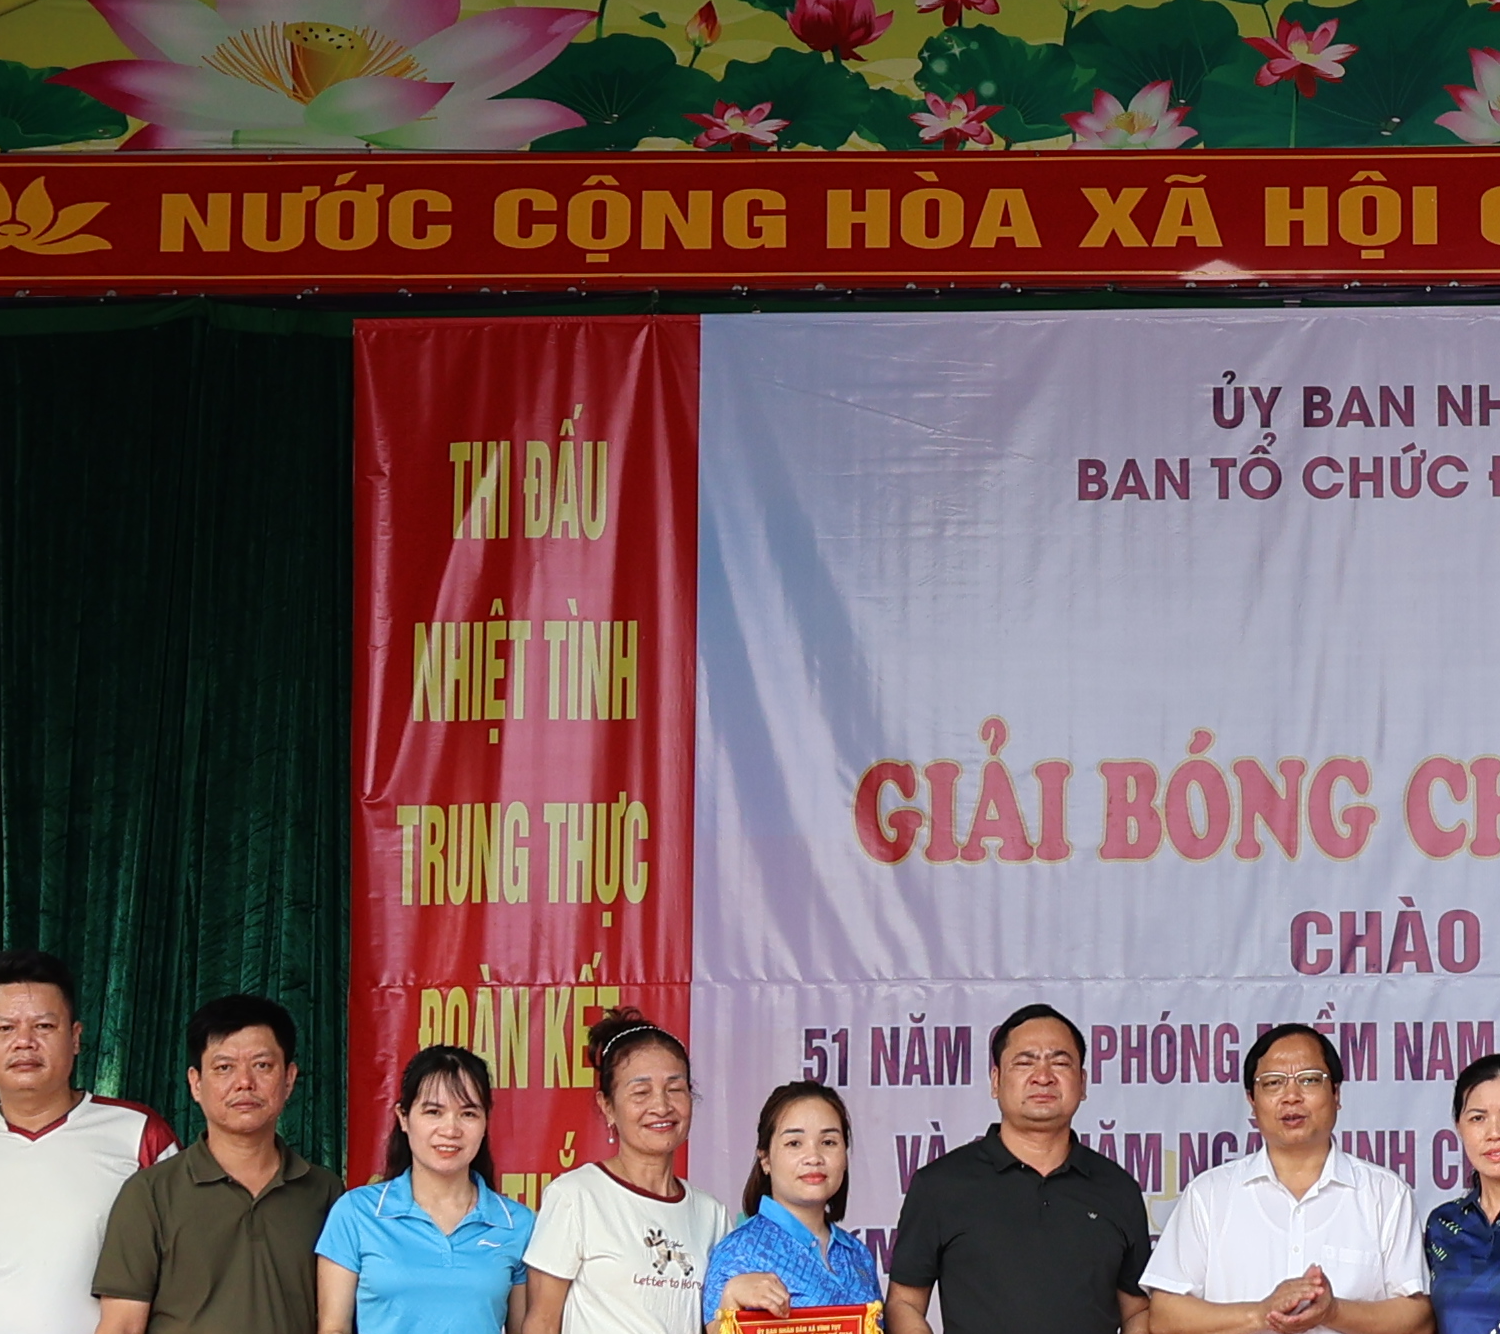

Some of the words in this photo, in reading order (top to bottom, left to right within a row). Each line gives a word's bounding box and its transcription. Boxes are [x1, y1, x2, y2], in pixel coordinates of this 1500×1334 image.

[160, 171, 451, 252] NƯỚC
[494, 175, 786, 262] CỘNG
[827, 172, 1041, 249] HÒA
[1079, 175, 1222, 247] XÃ
[1265, 171, 1437, 259] HỘI
[1213, 371, 1282, 429] ỦY
[1303, 386, 1414, 427] BAN
[449, 441, 510, 540] THI
[523, 404, 608, 540] ĐẤU
[1078, 458, 1189, 500] BAN
[1210, 432, 1282, 500] TỔ
[1302, 442, 1468, 499] CHỨC
[413, 598, 531, 744] NHIỆT
[543, 598, 637, 721] TÌNH
[855, 719, 1070, 865] GIẢI
[1100, 730, 1376, 860] BÓNG
[396, 801, 530, 906] TRUNG
[543, 790, 650, 928] THỰC
[1291, 897, 1480, 975] CHÀO
[418, 964, 529, 1088] ĐOÀN
[804, 1028, 848, 1087] 51
[871, 1015, 971, 1086] NĂM
[1100, 1010, 1239, 1084] PHÓNG
[1394, 1021, 1494, 1081] NAM
[633, 1274, 664, 1287] Letter
[670, 1277, 679, 1288] to
